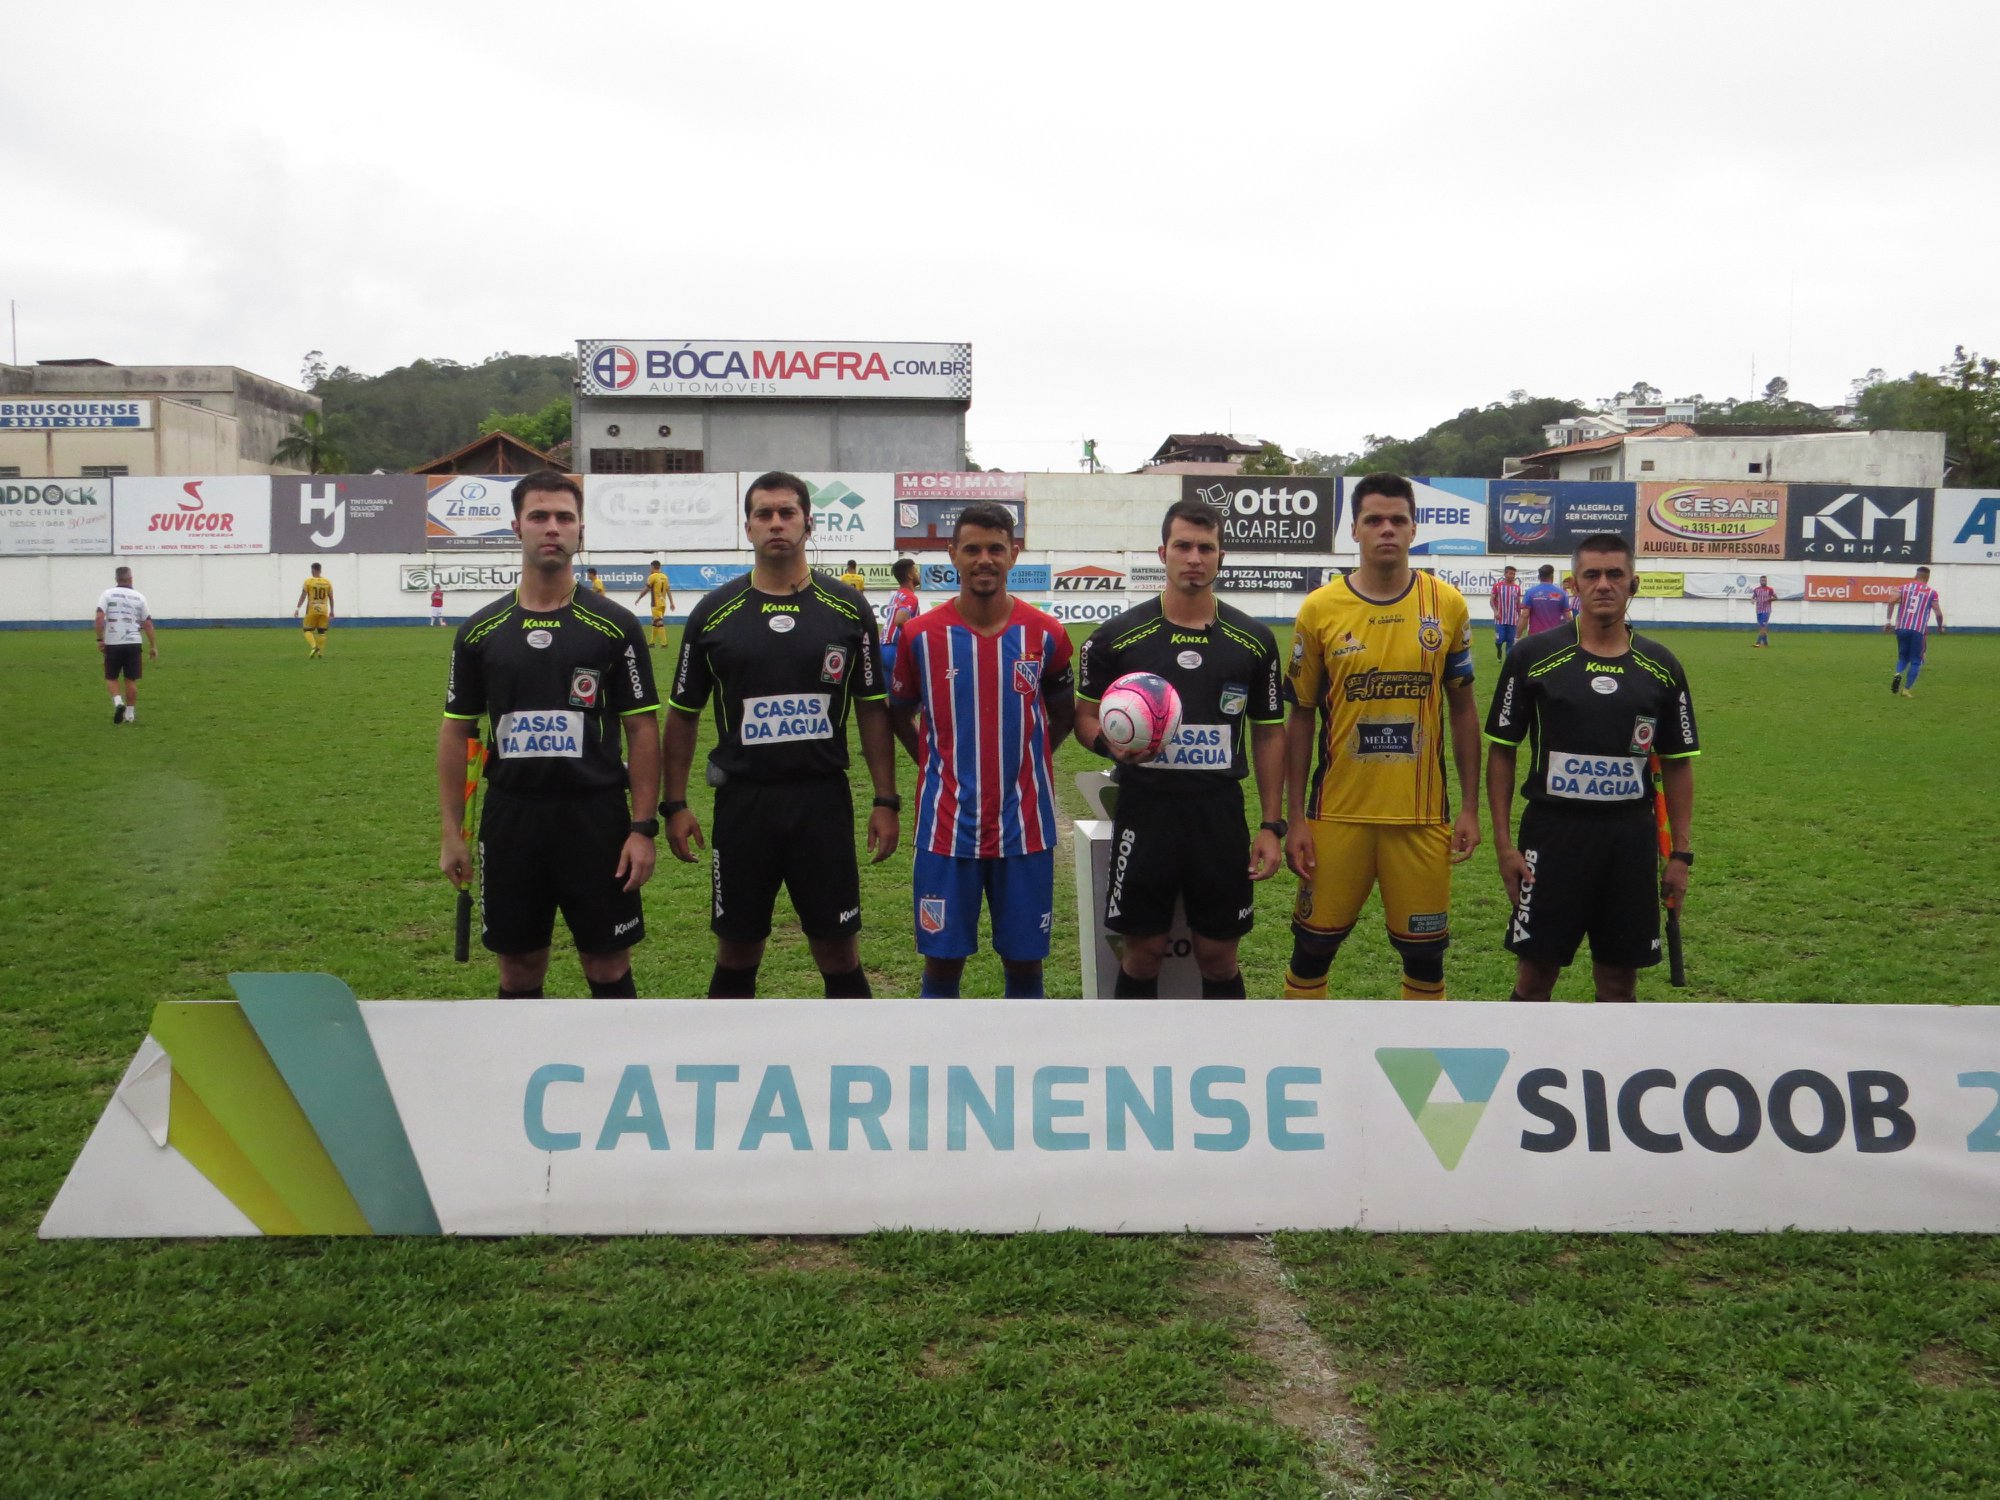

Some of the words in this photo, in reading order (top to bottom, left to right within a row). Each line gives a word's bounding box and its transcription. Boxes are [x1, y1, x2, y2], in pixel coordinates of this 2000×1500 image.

[649, 381, 777, 393] AUTOMÓVEIS
[1, 404, 139, 416] BRUSQUENSE
[9, 418, 113, 427] 3351-3302
[1234, 487, 1318, 516] otto
[1673, 498, 1778, 514] CESARI
[468, 506, 501, 516] MELO
[1415, 508, 1470, 525] NIFEBE
[1503, 509, 1551, 525] Uvel
[148, 513, 234, 532] SUVICOR
[814, 513, 865, 532] FRA
[1224, 519, 1316, 539] ACAREJO
[1692, 523, 1746, 534] 3351-0214
[1643, 541, 1687, 553] ALUGUEL
[1691, 542, 1704, 553] DE
[1708, 543, 1780, 554] IMPRESSORAS
[430, 566, 522, 585] twist-tur
[869, 567, 895, 577] MILI
[1232, 570, 1261, 579] PIZZA
[1263, 571, 1303, 579] LITORAL
[1053, 577, 1127, 590] KITAL
[1238, 580, 1293, 589] 3351-4950
[1808, 583, 1850, 598] Level
[1862, 585, 1892, 595] COM
[313, 587, 326, 600] 10
[761, 603, 800, 613] KANXA
[1053, 605, 1122, 620] SICOOB
[522, 619, 561, 629] KANXA
[1170, 633, 1208, 644] KANXA
[680, 643, 690, 684] SICOOB
[863, 645, 873, 686] SICOOB
[1585, 662, 1625, 674] KANXA
[627, 659, 643, 699] SICOOB
[1269, 672, 1278, 711] SICOOB
[753, 699, 821, 719] CASAS
[745, 721, 773, 740] DA
[777, 717, 830, 737] ÁGUA
[1680, 705, 1694, 745] SICOOB
[525, 733, 577, 753] ÁGUA
[1171, 729, 1220, 747] ASAS
[1363, 735, 1408, 744] MELLY'S
[1153, 750, 1169, 764] A
[1174, 746, 1228, 765] ÁGUA
[1564, 758, 1635, 777] CASAS
[1552, 776, 1580, 793] DA
[1585, 778, 1641, 796] ÁGUA
[1113, 828, 1136, 901] SICOOB
[713, 849, 723, 903] SICOOB
[615, 916, 640, 936] KANXA
[523, 1063, 1326, 1152] CATARINENSE
[1516, 1068, 1917, 1154] SICOOB
